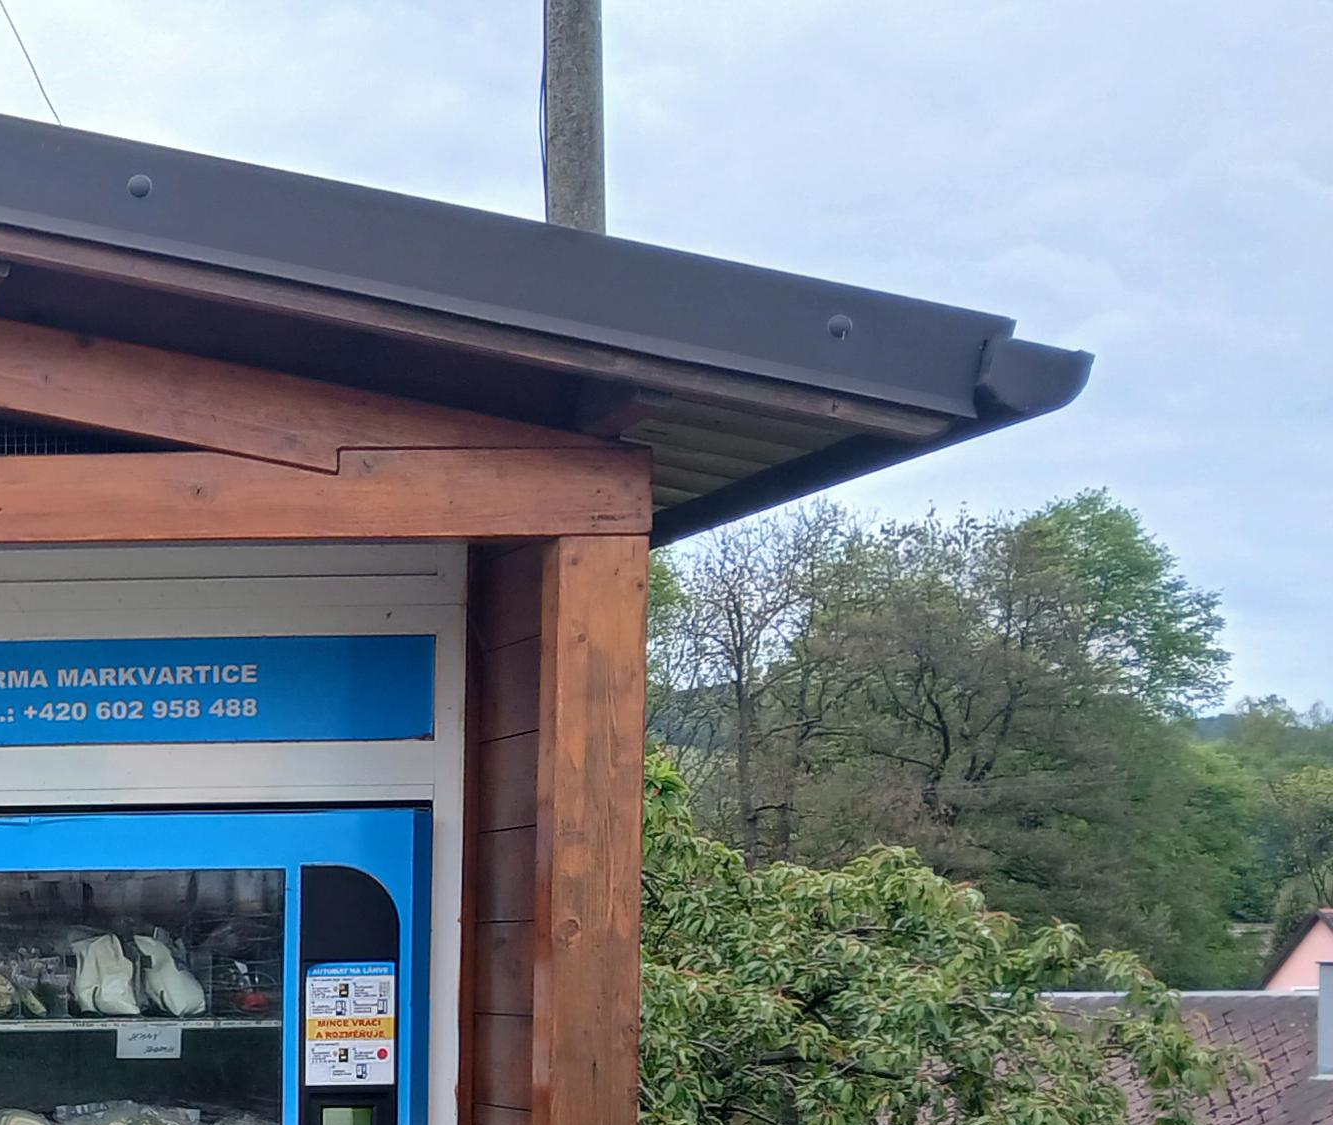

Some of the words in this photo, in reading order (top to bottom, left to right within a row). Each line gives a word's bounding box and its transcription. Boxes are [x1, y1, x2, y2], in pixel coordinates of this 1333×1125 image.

[57, 664, 258, 687] MARKVARTICE
[24, 702, 87, 721] +420
[96, 700, 144, 719] 602
[152, 699, 200, 718] 958
[208, 698, 257, 717] 488
